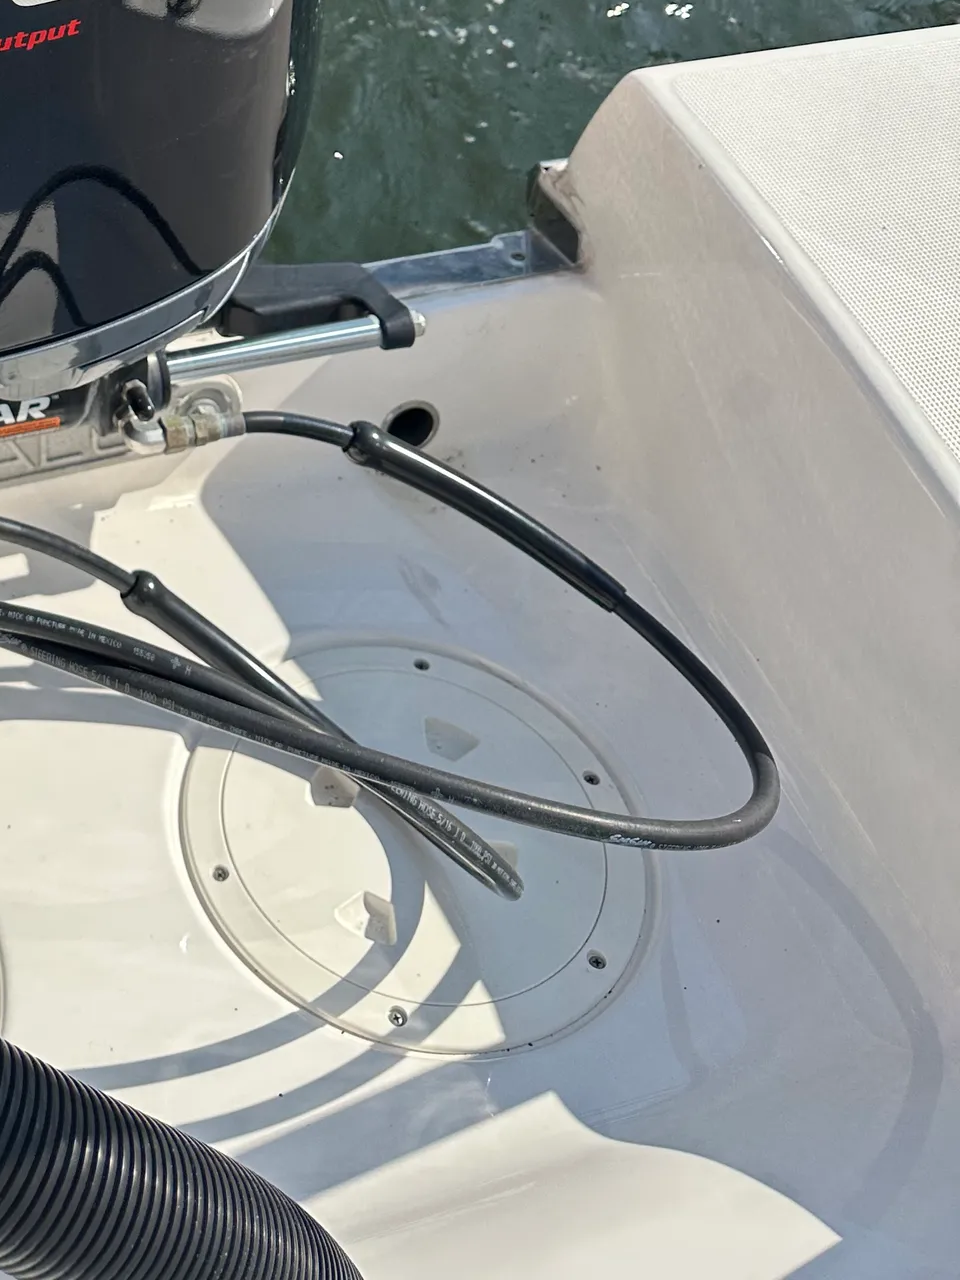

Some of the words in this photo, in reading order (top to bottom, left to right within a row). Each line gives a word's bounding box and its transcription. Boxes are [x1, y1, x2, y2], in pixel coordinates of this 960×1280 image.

[30, 646, 67, 668] STEERING
[69, 660, 88, 678] HOSE
[91, 669, 111, 687] 5/16
[418, 800, 436, 820] HOSE
[436, 813, 452, 832] 5/16
